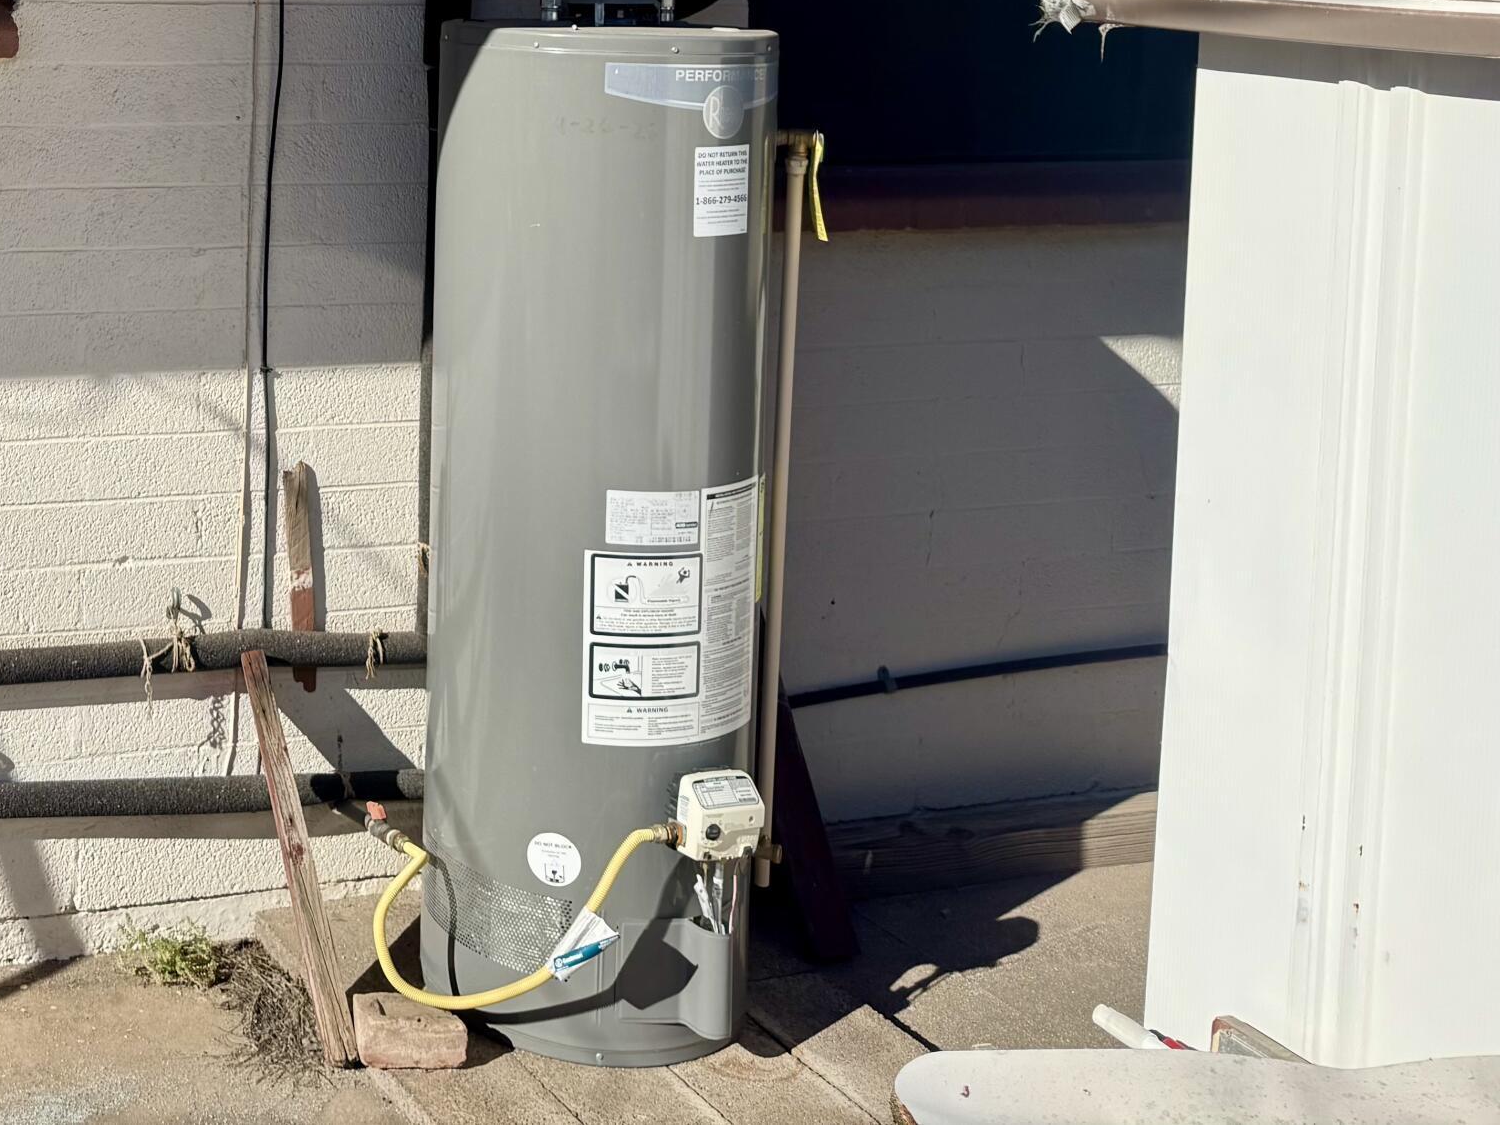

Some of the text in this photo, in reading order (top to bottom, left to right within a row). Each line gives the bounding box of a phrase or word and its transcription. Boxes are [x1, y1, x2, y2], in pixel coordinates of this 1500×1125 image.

[675, 68, 766, 82] PERFORMCE
[723, 167, 746, 175] PURCHASE
[696, 194, 748, 205] 1-866-279-4566
